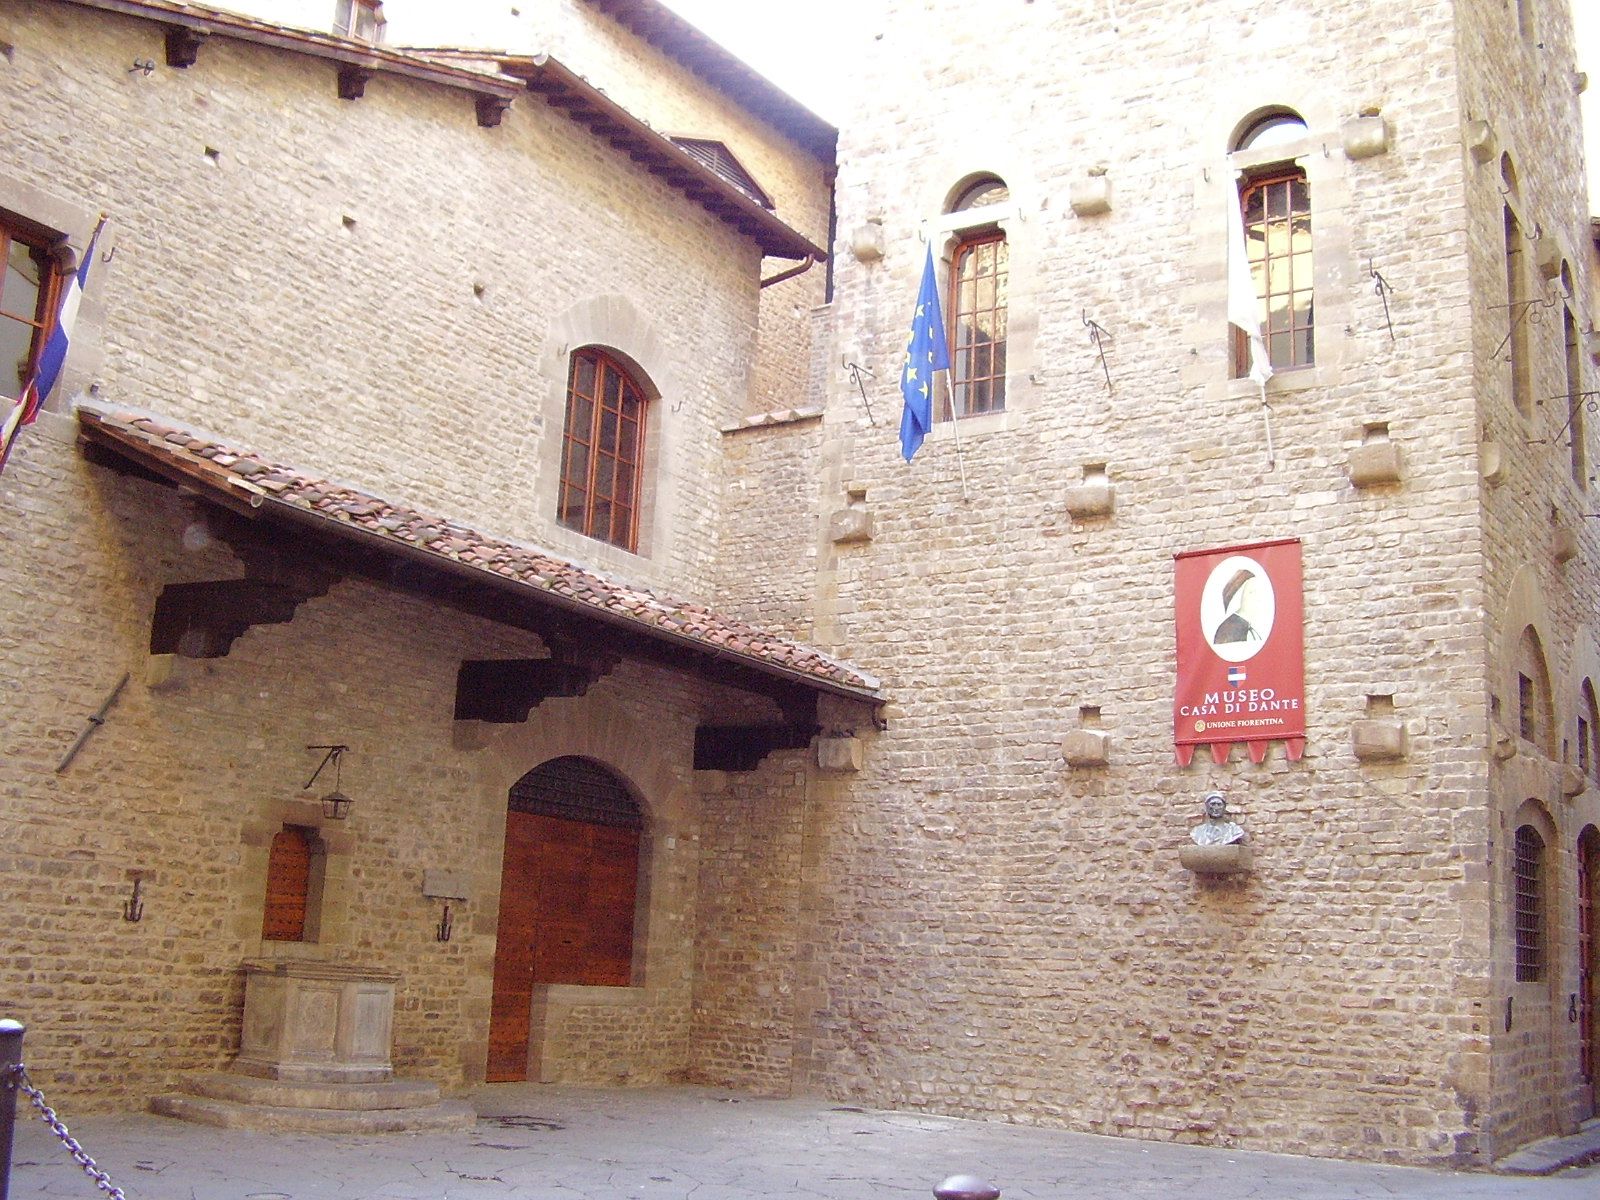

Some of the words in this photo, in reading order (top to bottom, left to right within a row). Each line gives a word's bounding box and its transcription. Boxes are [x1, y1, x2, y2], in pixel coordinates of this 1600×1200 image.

[1204, 688, 1275, 705] MUSEO
[1180, 705, 1217, 716] CASA
[1225, 703, 1240, 714] DI
[1248, 699, 1299, 712] DANTE
[1206, 721, 1236, 729] UNIONE
[1237, 718, 1284, 727] FIORENTINA
